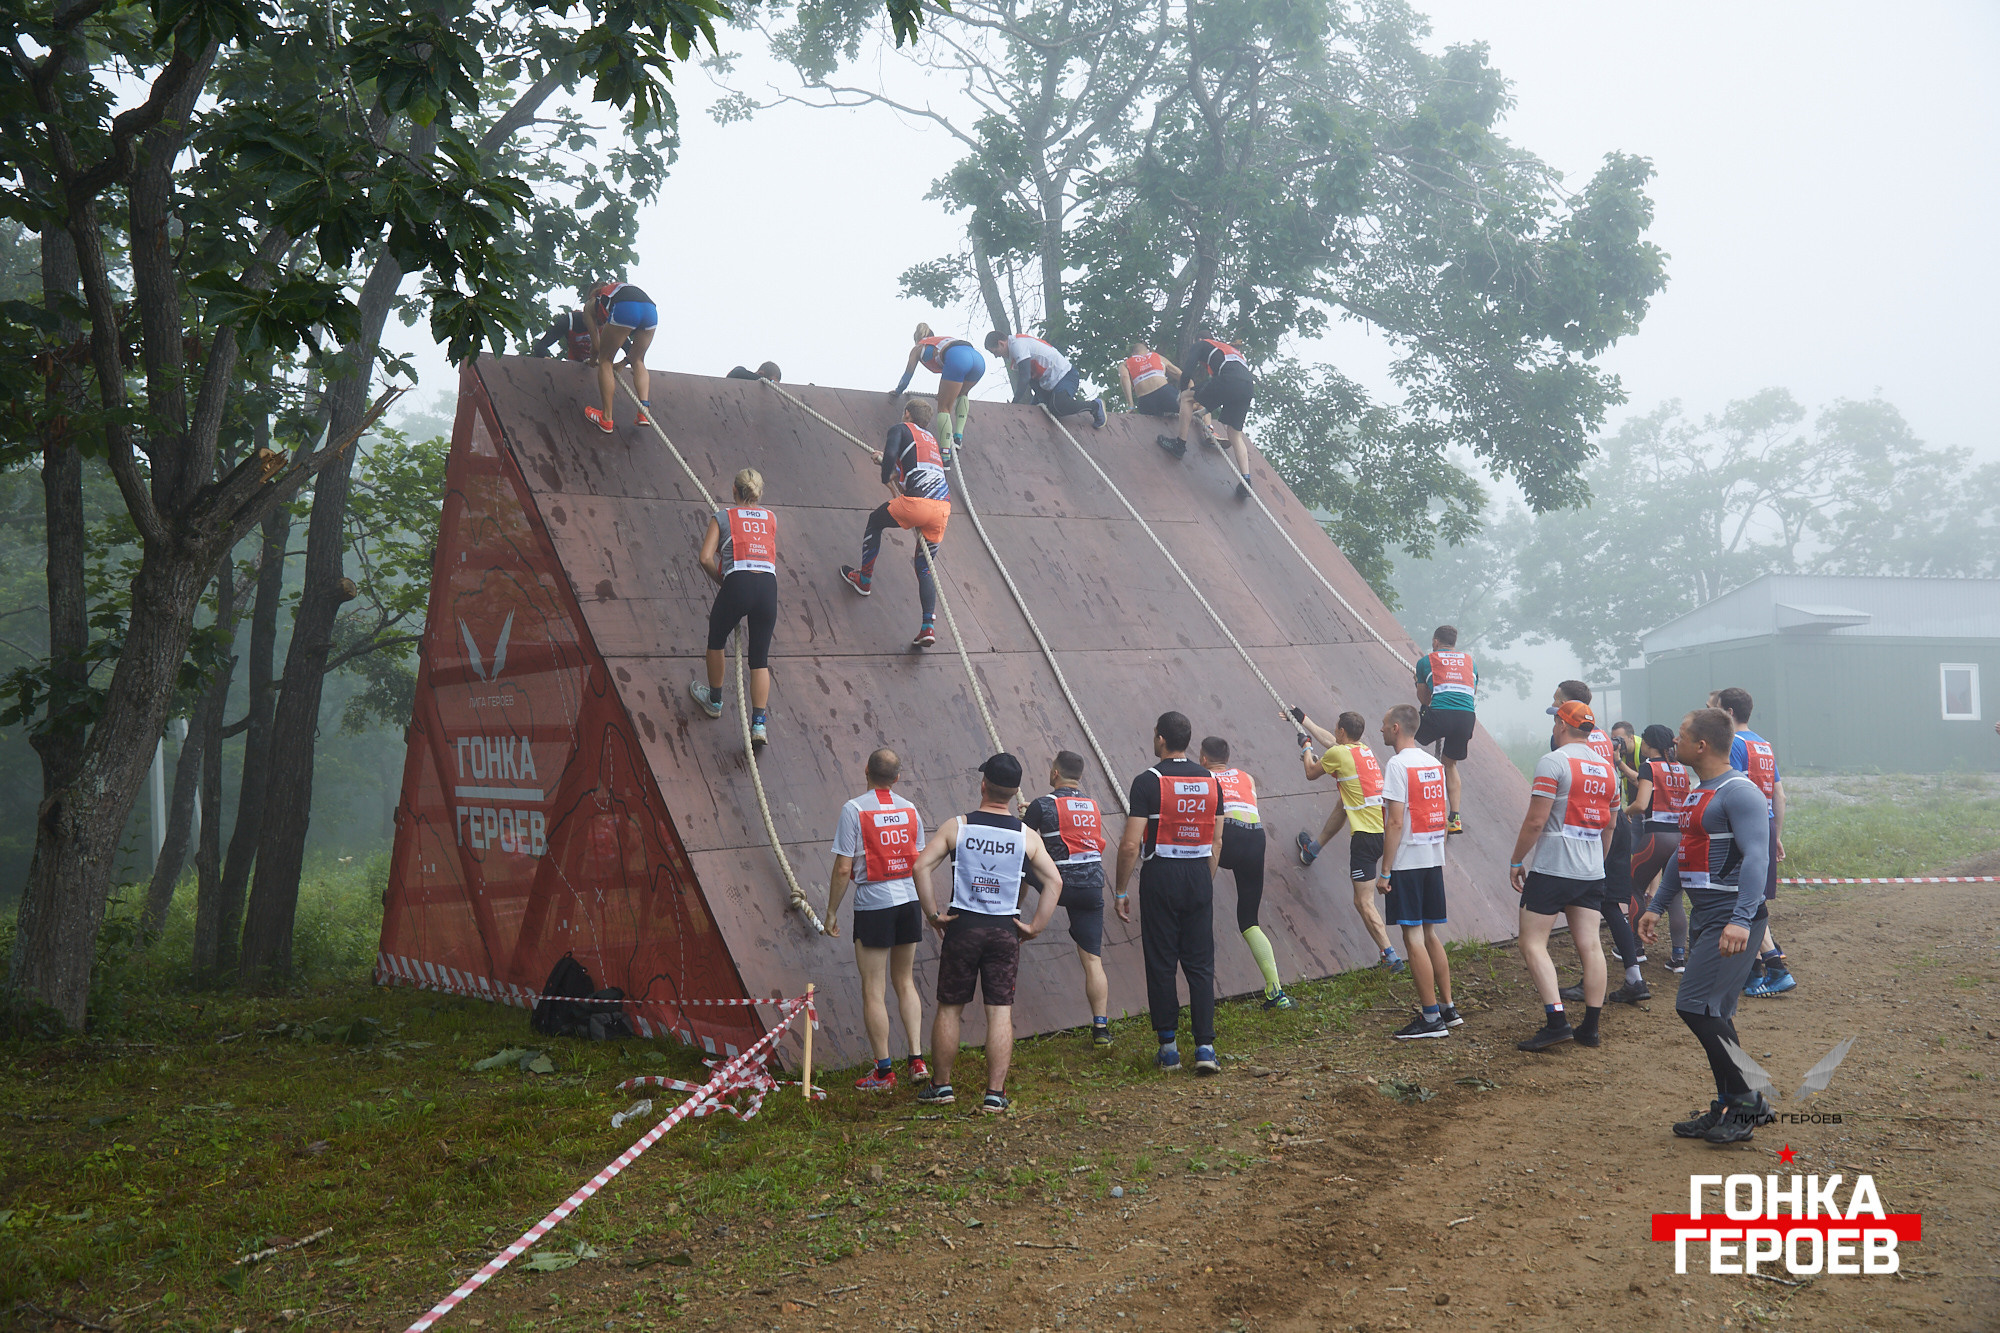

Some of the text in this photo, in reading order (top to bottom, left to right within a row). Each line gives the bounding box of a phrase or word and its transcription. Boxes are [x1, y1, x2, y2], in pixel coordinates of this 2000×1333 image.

[743, 521, 768, 534] 031
[469, 695, 514, 708] ЛИГА ГЕРОЕВ
[1594, 745, 1611, 757] 011
[457, 736, 537, 780] ГОНКА
[1760, 758, 1774, 770] 012
[1583, 780, 1606, 795] 034
[1666, 775, 1685, 788] 010
[1423, 785, 1442, 799] 033
[1177, 799, 1206, 813] 024
[883, 815, 900, 823] PRO
[1072, 814, 1096, 827] 022
[456, 806, 547, 856] ГЕРОЕВ
[880, 829, 909, 845] 005
[965, 837, 1015, 855] СУДЬЯ
[887, 863, 908, 871] ГЕРОЕВ
[888, 857, 906, 865] ГОНКА
[973, 876, 1000, 885] ГОНКА
[971, 885, 1000, 894] ГЕРОЕВ
